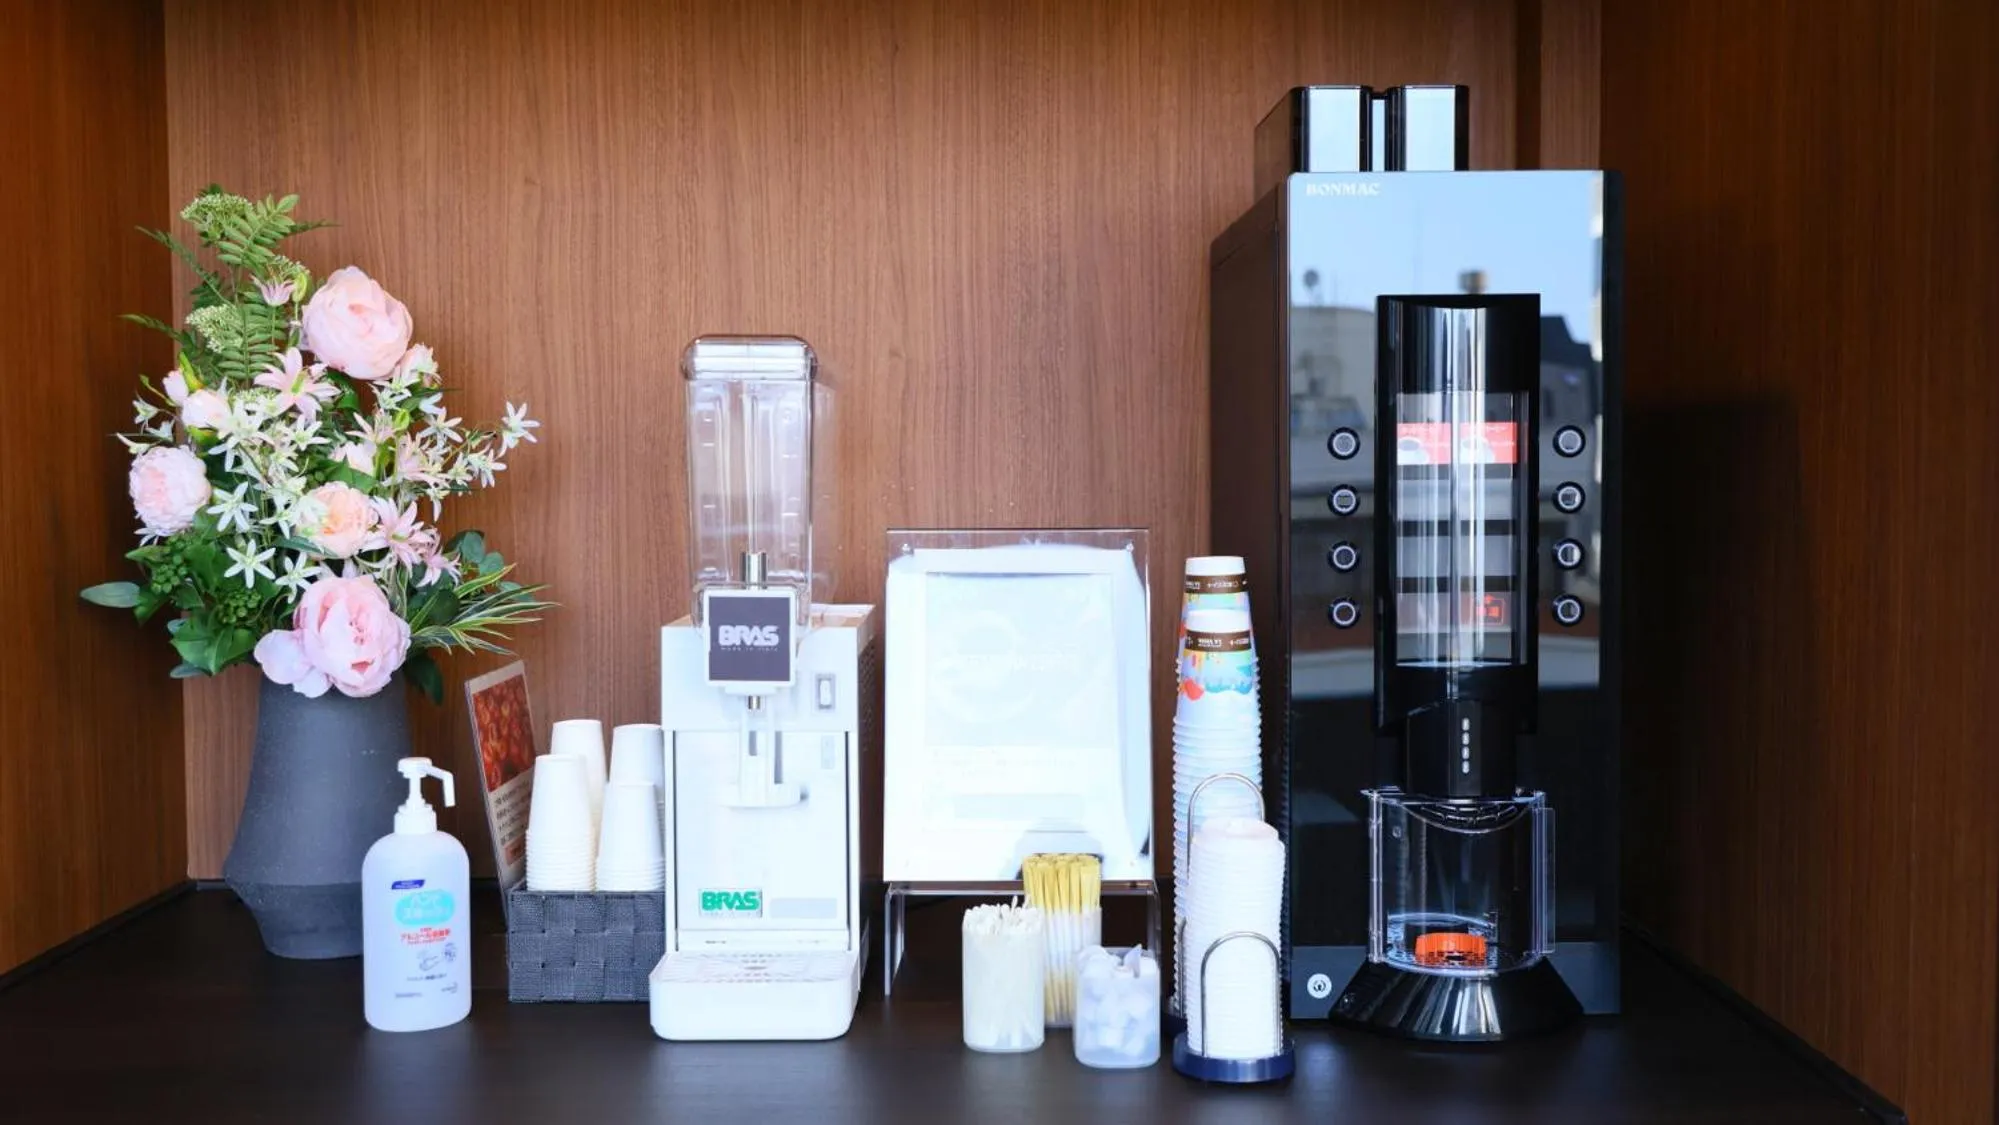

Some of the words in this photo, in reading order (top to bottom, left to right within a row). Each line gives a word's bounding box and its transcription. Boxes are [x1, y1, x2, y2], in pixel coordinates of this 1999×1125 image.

[1306, 181, 1381, 197] BONMAC
[718, 624, 779, 647] BRAS
[701, 891, 760, 911] BRAS
